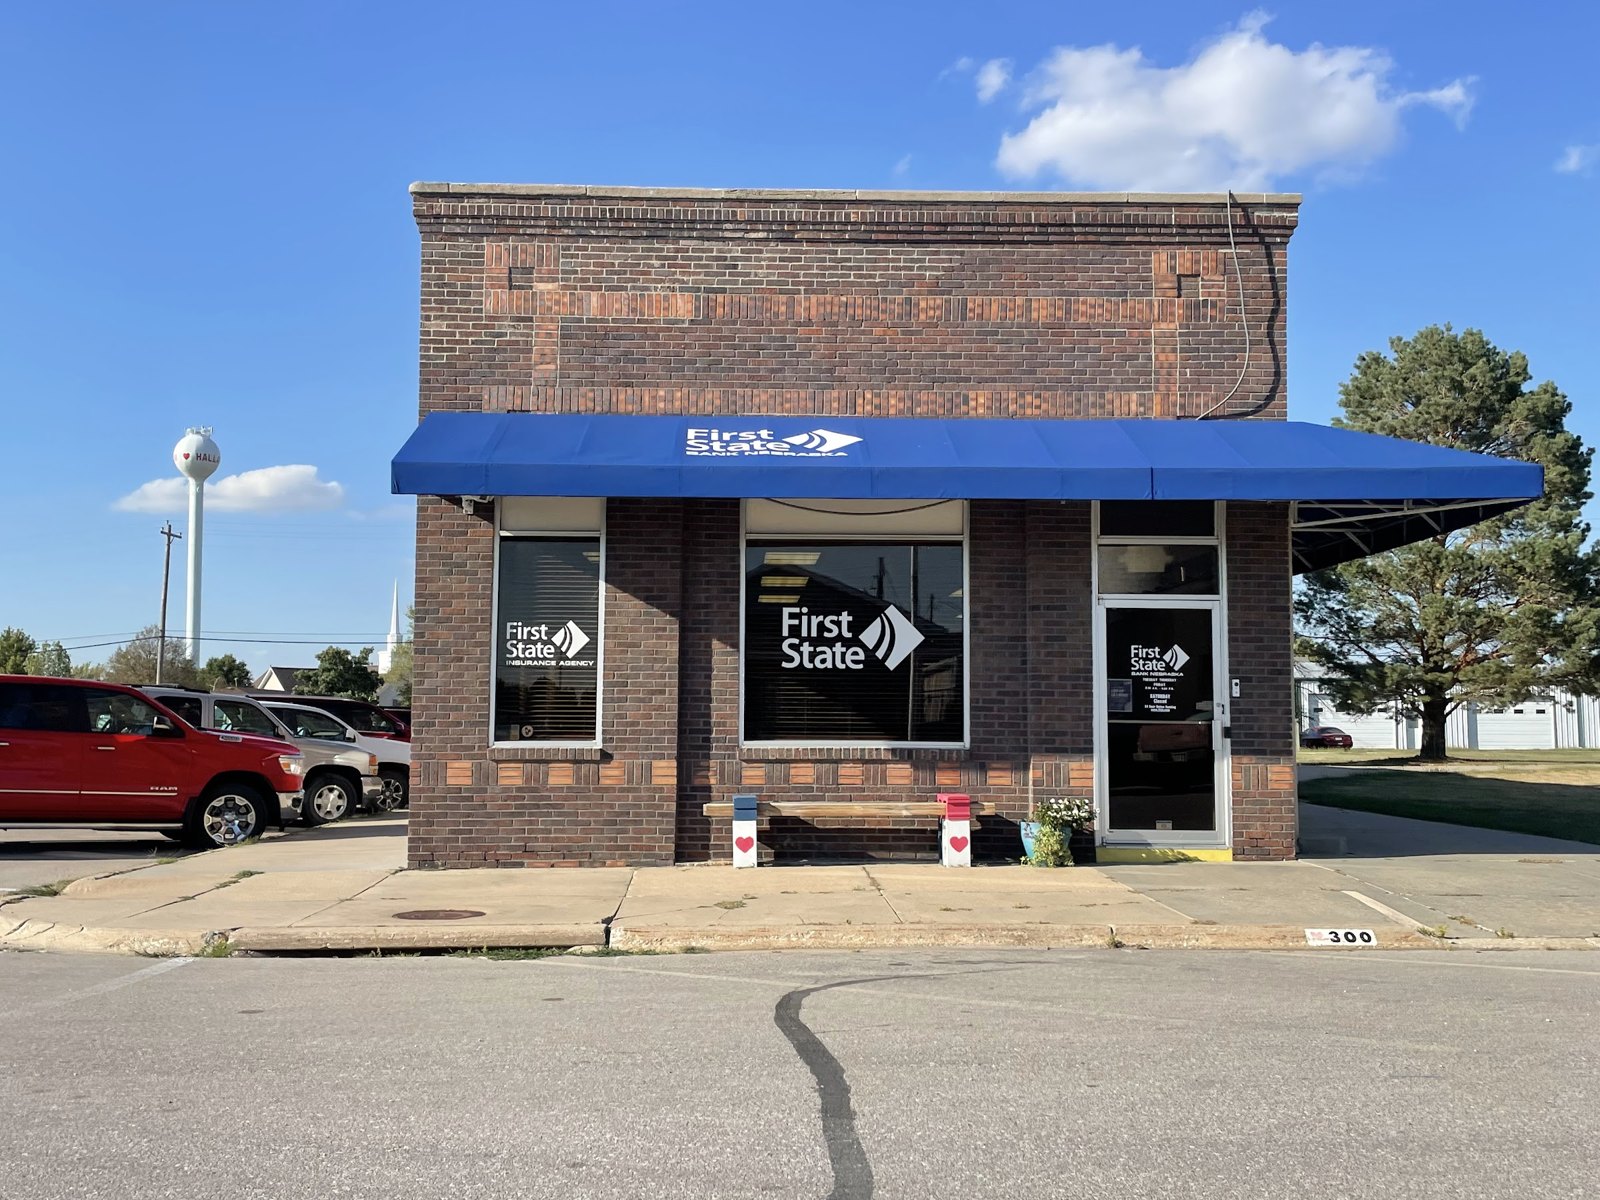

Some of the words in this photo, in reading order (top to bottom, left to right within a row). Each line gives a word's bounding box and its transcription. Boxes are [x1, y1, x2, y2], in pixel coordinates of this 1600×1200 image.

[687, 429, 774, 440] First
[686, 440, 791, 452] State
[781, 607, 853, 638] First
[506, 621, 548, 640] First
[506, 639, 555, 658] State
[781, 637, 866, 670] State
[1131, 645, 1160, 658] First
[1131, 658, 1165, 671] State
[1328, 931, 1372, 943] 300
